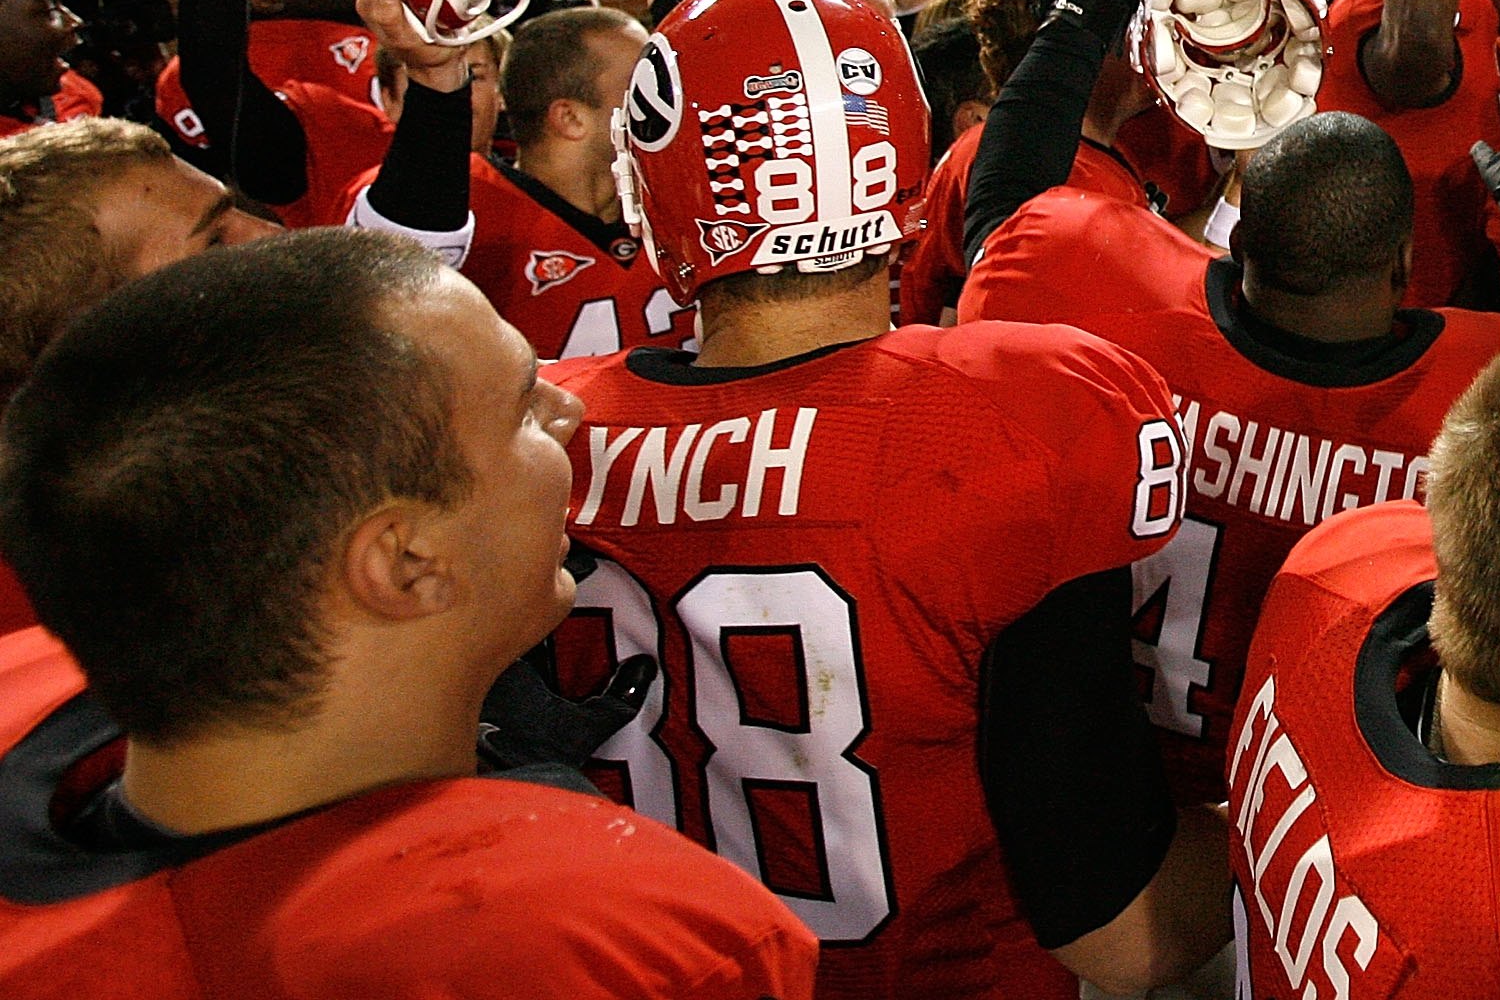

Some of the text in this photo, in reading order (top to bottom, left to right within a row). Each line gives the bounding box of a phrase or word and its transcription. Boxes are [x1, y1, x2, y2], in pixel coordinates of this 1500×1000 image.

[842, 62, 876, 80] CV
[711, 224, 743, 251] SEC
[772, 214, 885, 256] schutt
